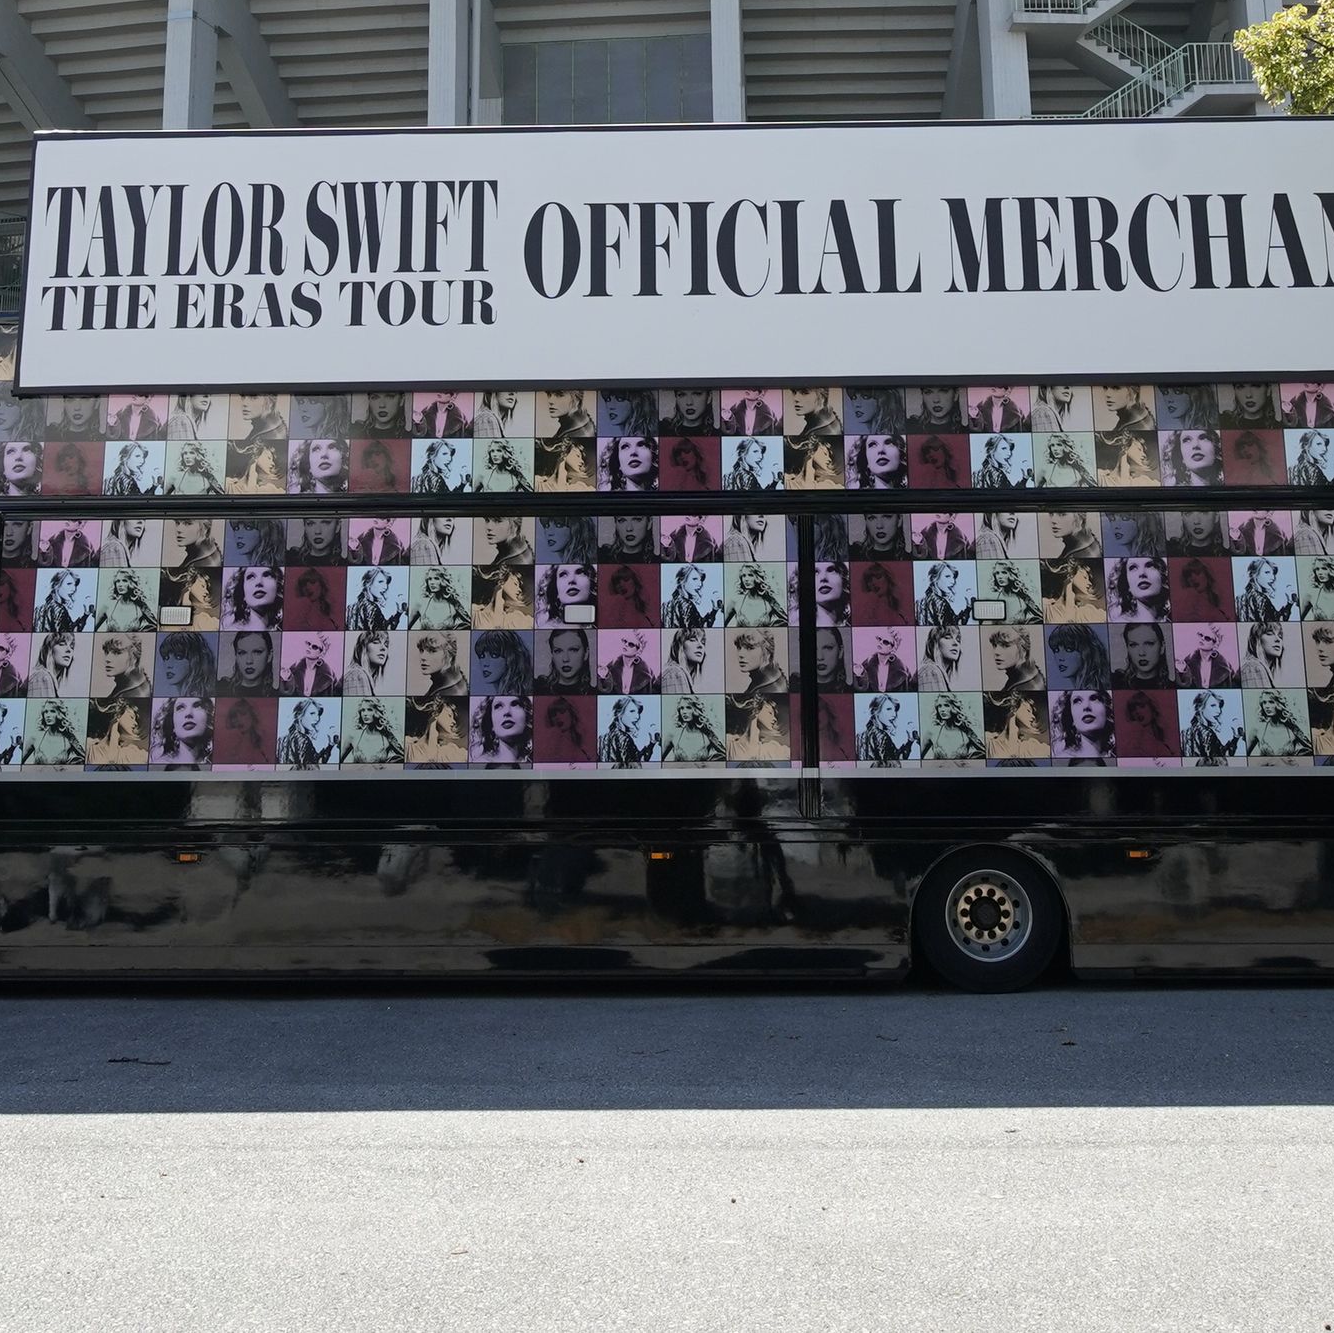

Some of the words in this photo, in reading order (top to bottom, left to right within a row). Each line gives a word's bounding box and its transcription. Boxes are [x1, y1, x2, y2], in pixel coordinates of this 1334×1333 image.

[43, 181, 288, 279] TAYLOR
[303, 179, 499, 277] SWIFT
[523, 197, 922, 300] OFFICIAL
[41, 284, 157, 332] THE
[173, 281, 323, 330] ERAS
[338, 279, 497, 327] TOUR
